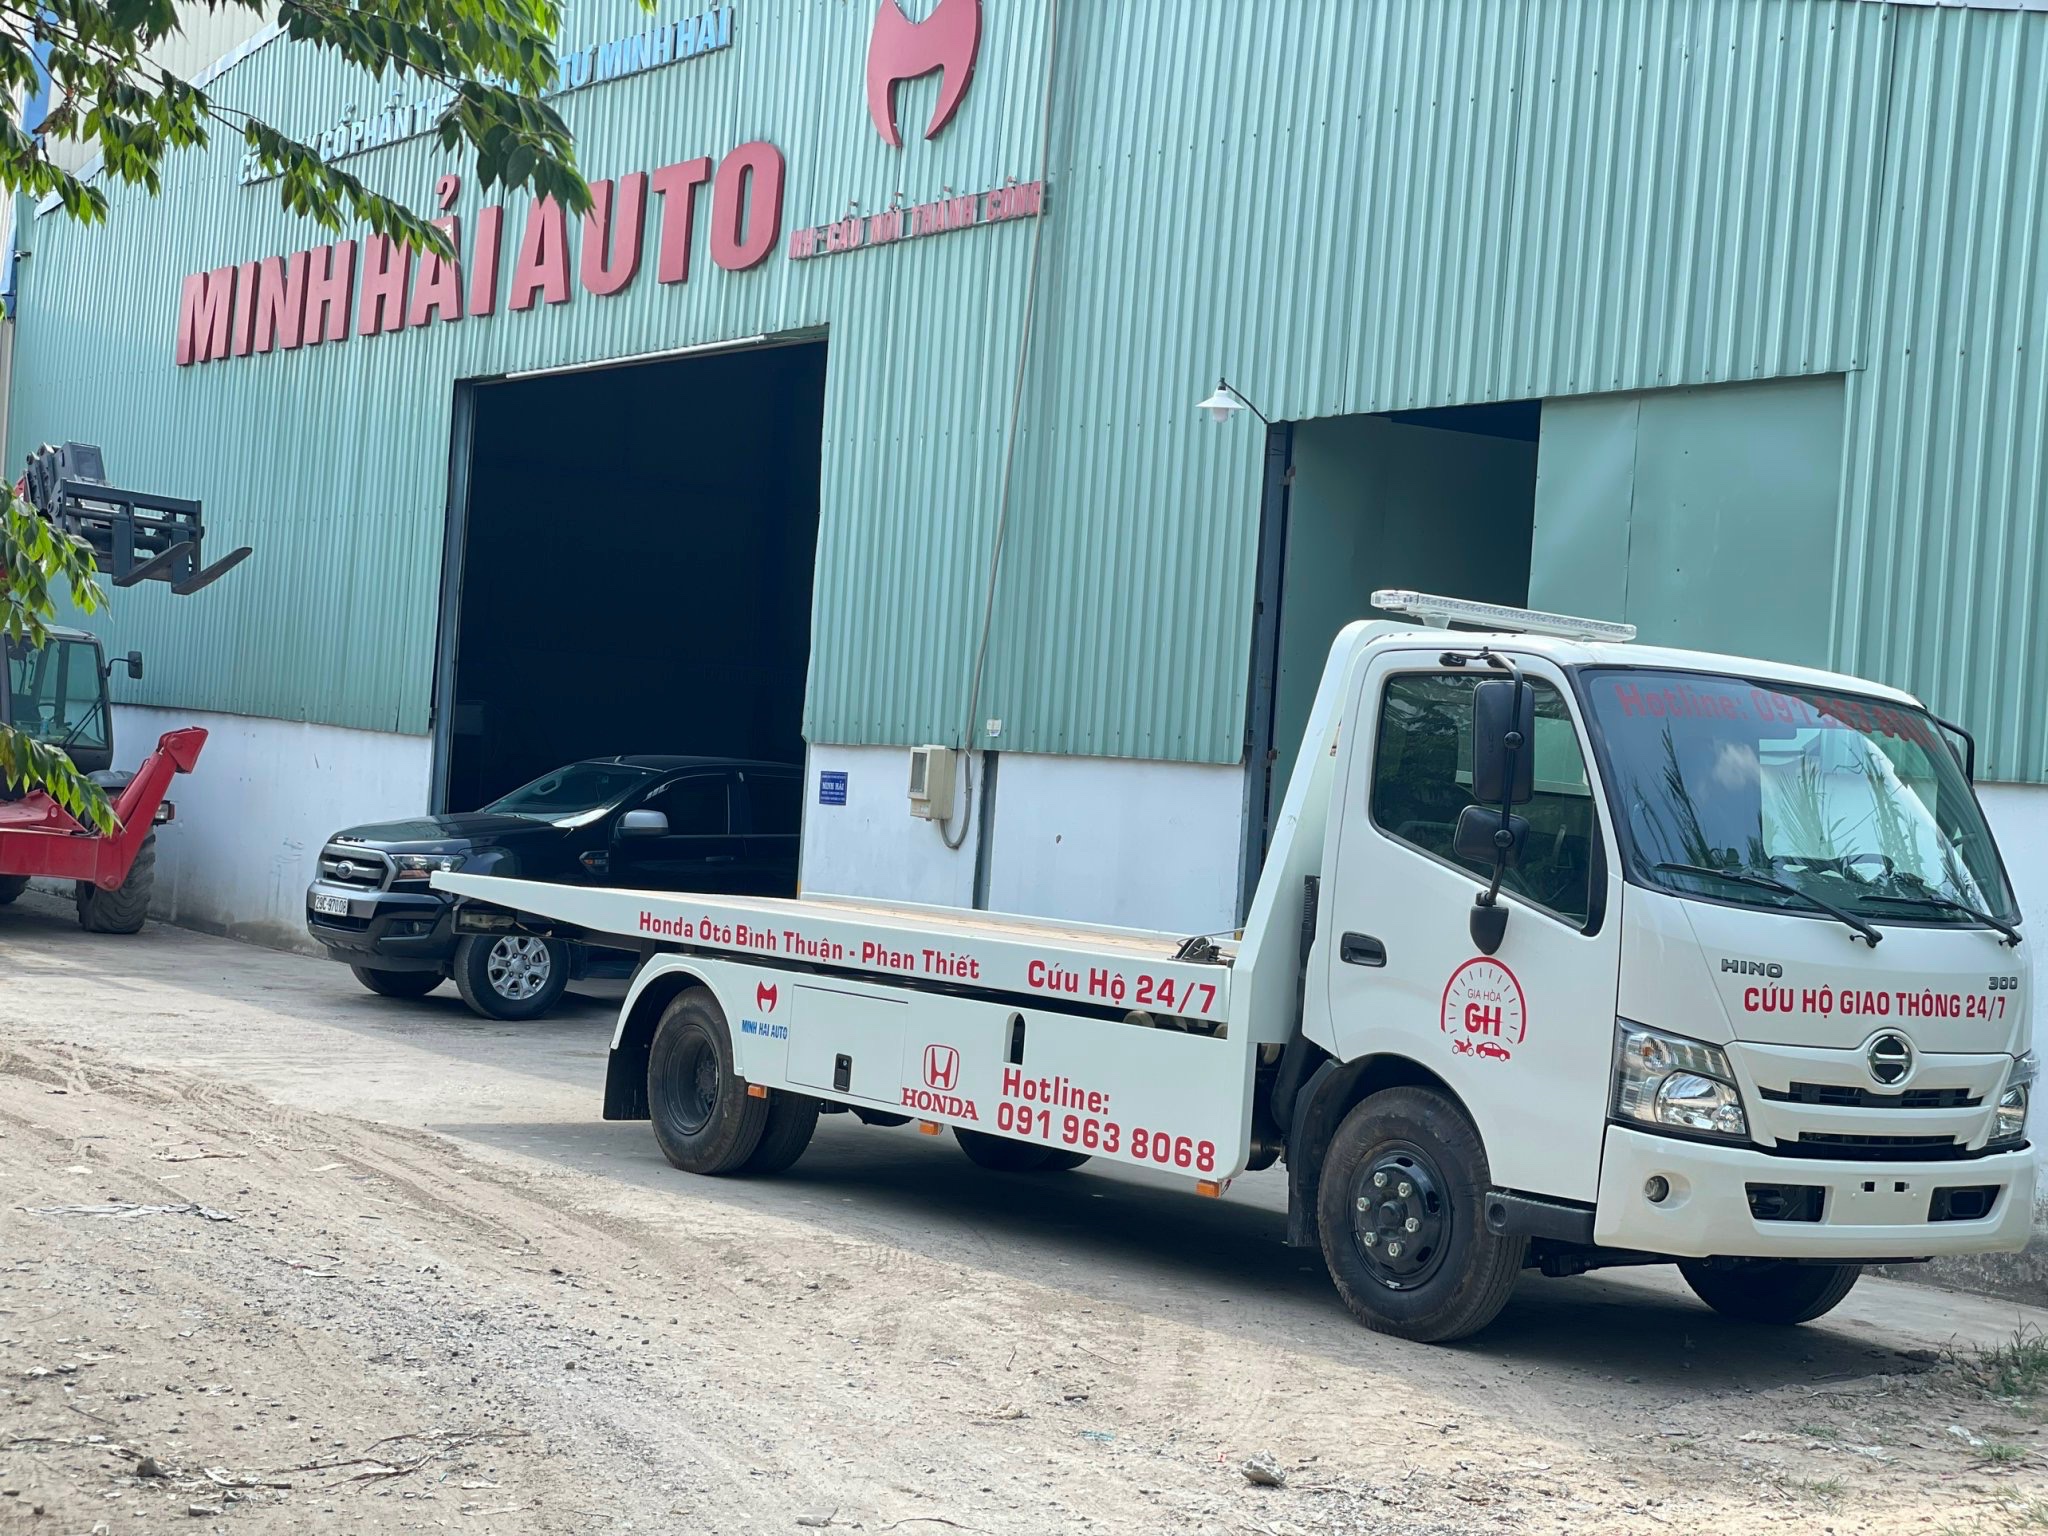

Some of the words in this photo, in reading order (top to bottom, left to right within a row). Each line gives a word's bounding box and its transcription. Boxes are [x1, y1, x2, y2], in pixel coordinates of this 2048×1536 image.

[351, 90, 413, 151] PHẦN
[598, 24, 674, 80] MINH
[911, 185, 978, 237] THÀNH
[985, 176, 1044, 222] CÔNG
[176, 240, 356, 366] MINH
[359, 175, 502, 336] HẢI
[509, 141, 785, 311] AUTO
[1614, 683, 1747, 720] Hotline:
[1751, 689, 1812, 726] 091
[639, 911, 693, 938] Honda
[699, 916, 731, 944] Ôtô
[736, 924, 776, 951] Bình
[783, 931, 842, 960] Thuận
[861, 941, 914, 970] Phan
[922, 949, 980, 980] Thiết
[1028, 960, 1079, 993] Cứu
[1089, 967, 1126, 1005] Hộ
[1135, 974, 1216, 1014] 24/7
[1721, 959, 1783, 978] HINO
[1988, 977, 2018, 990] 300
[1467, 988, 1481, 1000] GIA
[1744, 982, 1794, 1013] CỨU
[1802, 984, 1833, 1018] HỘ
[1840, 990, 1890, 1015] GIAO
[1896, 988, 1960, 1018] THÔNG
[1966, 994, 2006, 1021] 24/7
[741, 1020, 757, 1034] MINH
[771, 1025, 788, 1039] AUTO
[1465, 1003, 1502, 1037] GH
[901, 1087, 979, 1121] HONDA
[1003, 1067, 1109, 1115] Hotline:
[997, 1102, 1051, 1139] 091
[1062, 1114, 1120, 1152] 963
[1131, 1128, 1215, 1172] 8068
